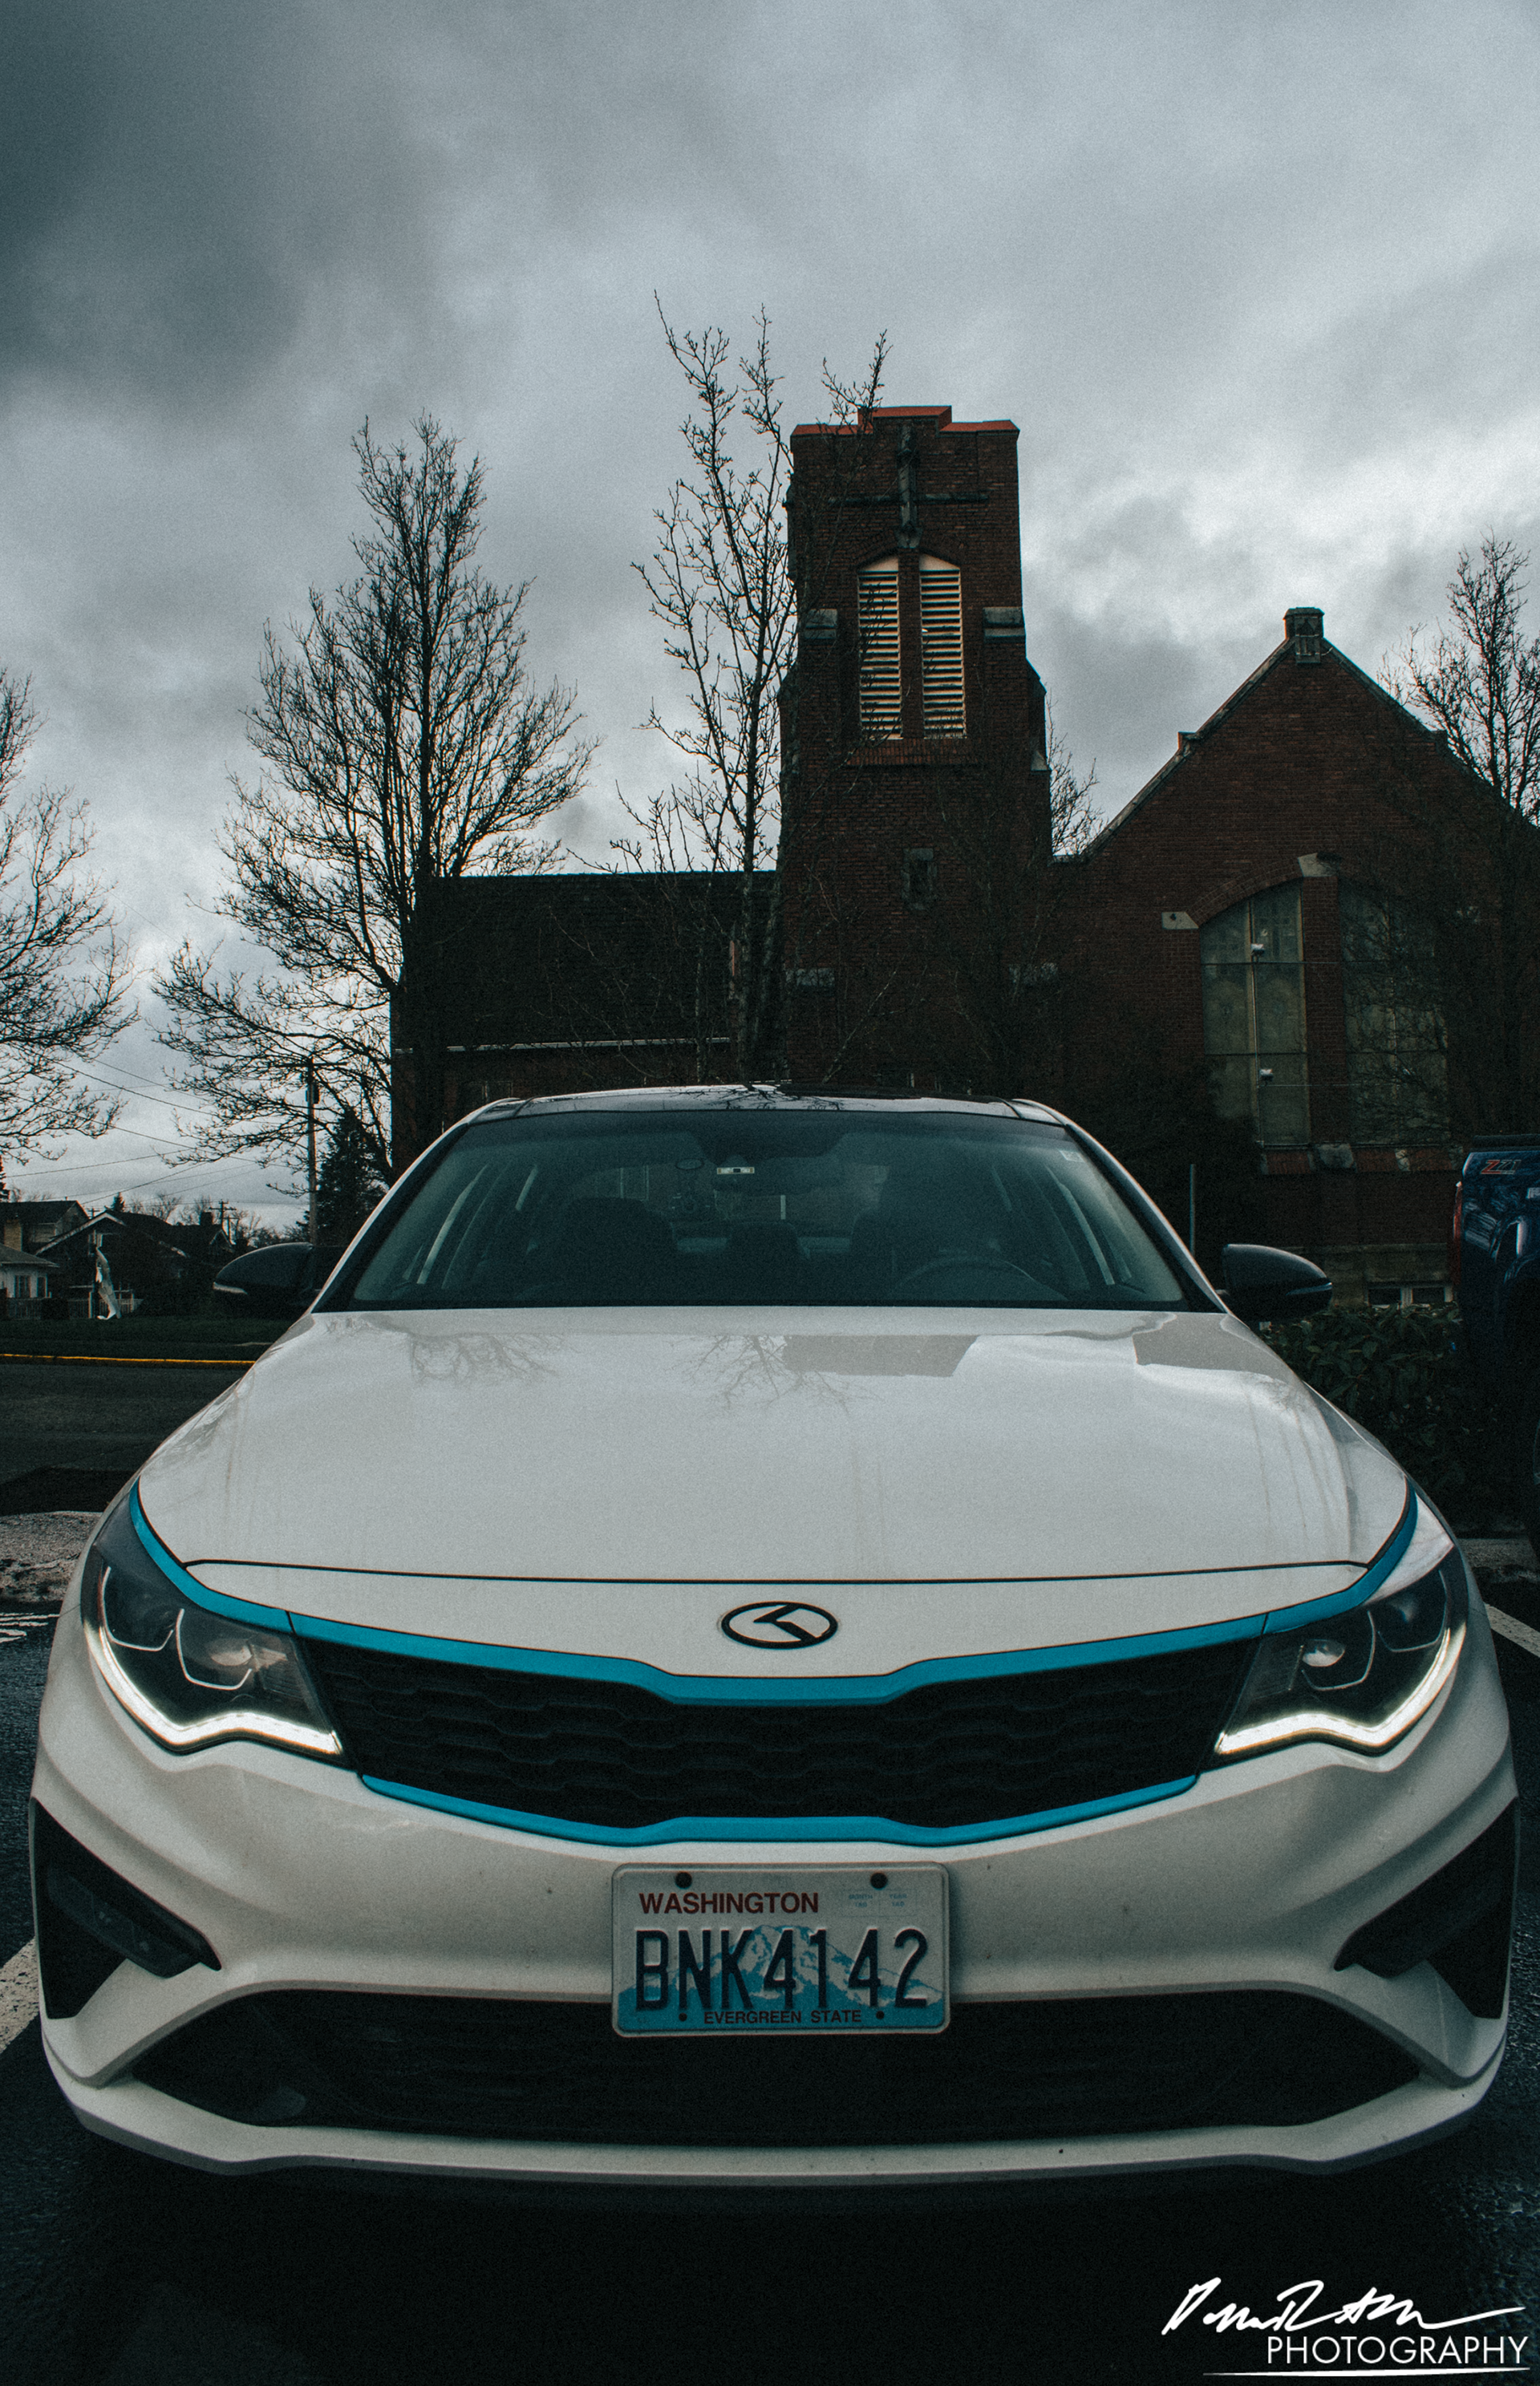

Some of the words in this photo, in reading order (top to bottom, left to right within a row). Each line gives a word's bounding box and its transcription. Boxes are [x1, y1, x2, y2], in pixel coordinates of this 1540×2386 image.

[1480, 1159, 1522, 1175] Z71
[638, 1891, 819, 1914] WASHINGTON
[636, 1928, 928, 2010] BNK4142
[703, 2010, 802, 2024] EVERGREEN
[810, 2009, 862, 2023] STATE
